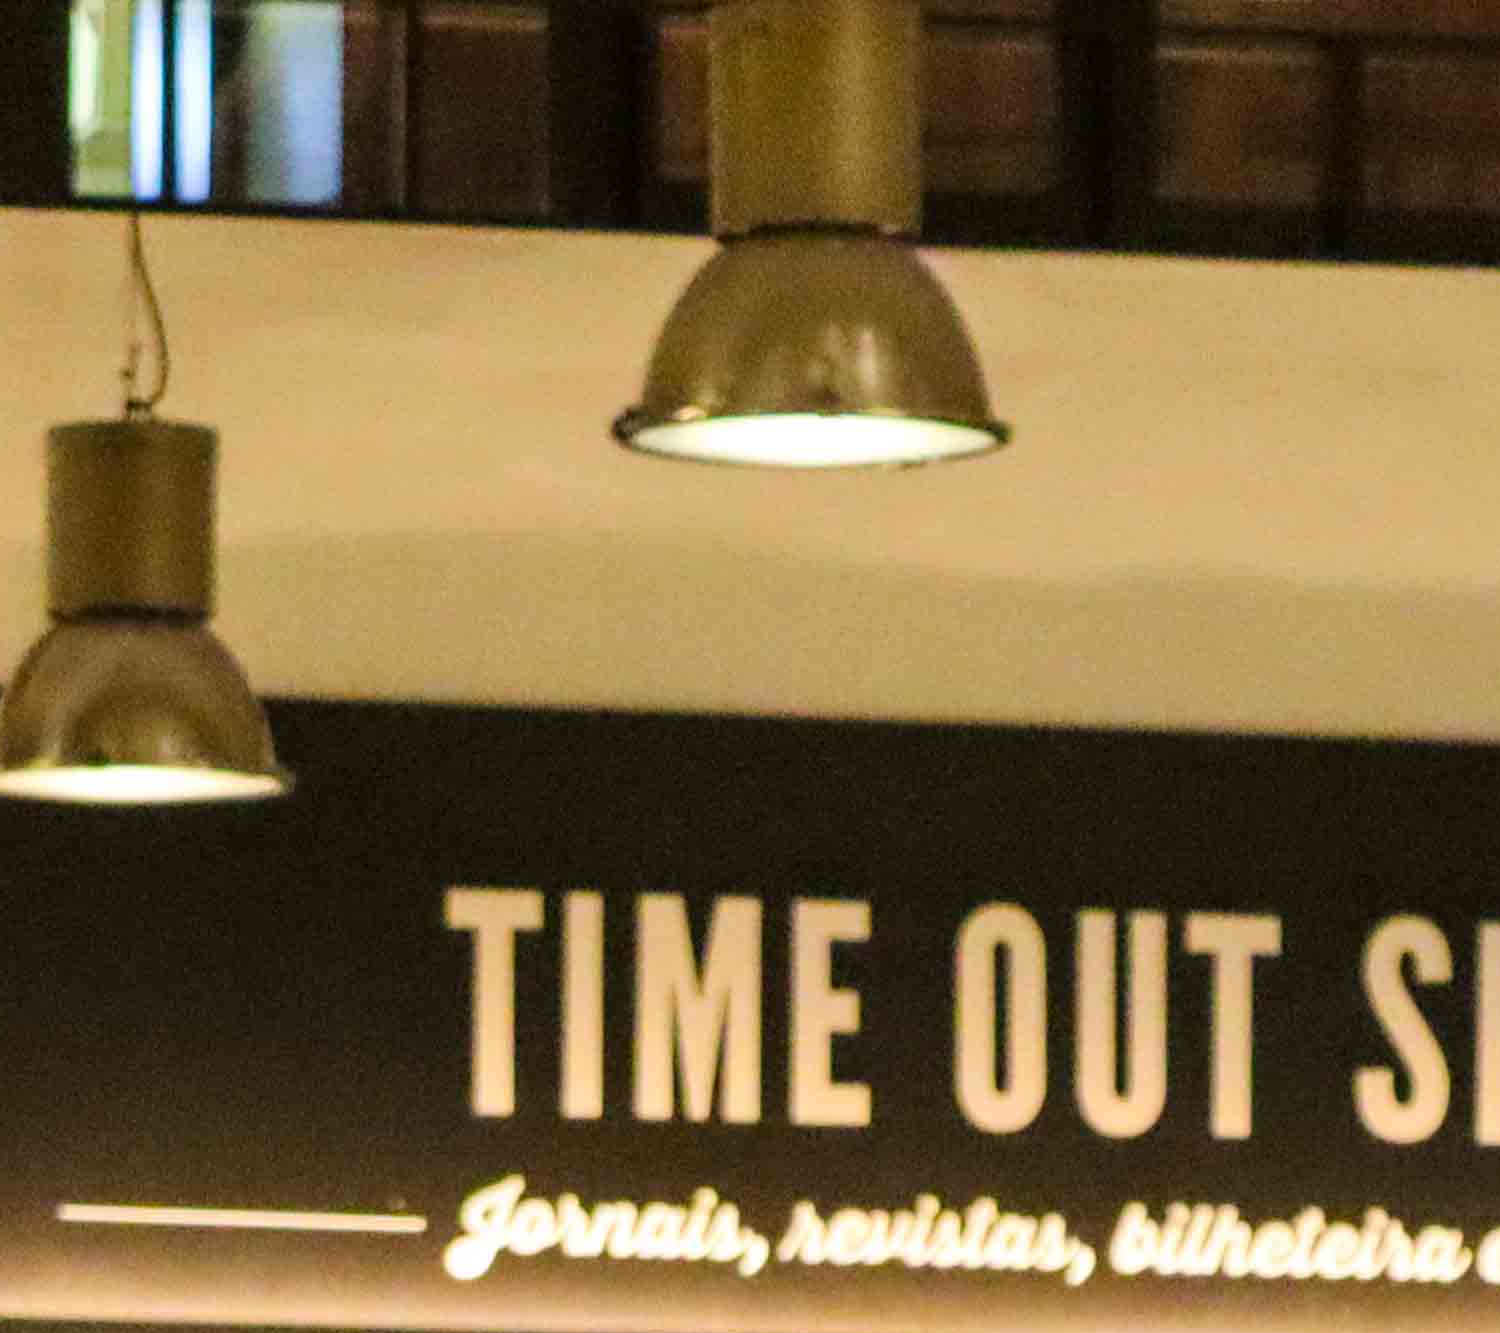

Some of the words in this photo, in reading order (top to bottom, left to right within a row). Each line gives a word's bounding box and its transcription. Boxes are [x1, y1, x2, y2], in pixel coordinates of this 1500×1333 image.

[443, 886, 873, 1129] TIME
[953, 902, 1283, 1141] OUT
[442, 1175, 770, 1281] Jornais,
